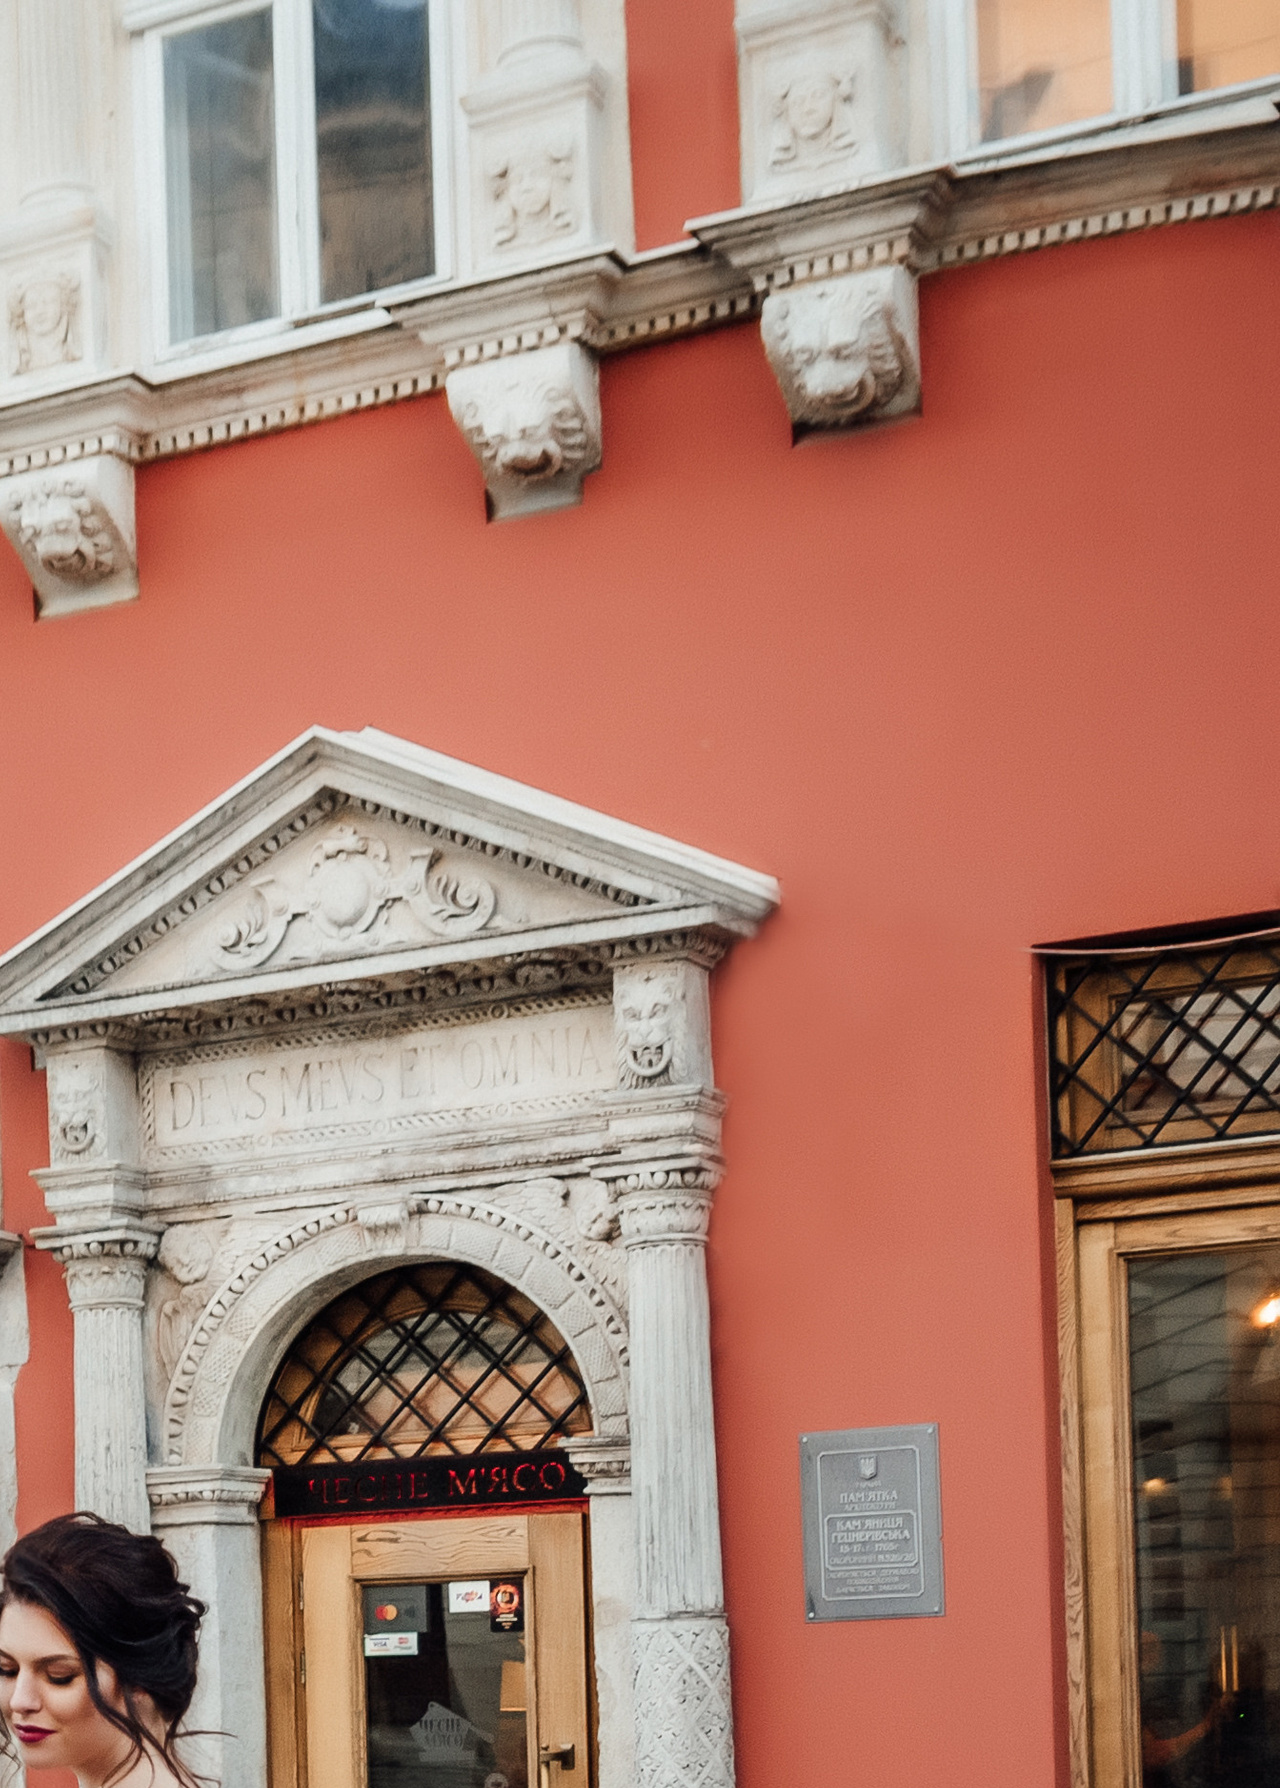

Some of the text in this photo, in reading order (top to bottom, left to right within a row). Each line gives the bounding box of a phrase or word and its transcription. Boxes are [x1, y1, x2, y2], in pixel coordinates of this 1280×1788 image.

[280, 1053, 385, 1117] MEVS
[399, 1044, 442, 1099] ET
[460, 1027, 602, 1090] OMNIA
[308, 1462, 565, 1504] ЧЕСНЕ М'ЯСО
[840, 1490, 898, 1504] ПАМ'ЯТКА
[836, 1517, 903, 1531] КАМ'ЯНИЦЯ
